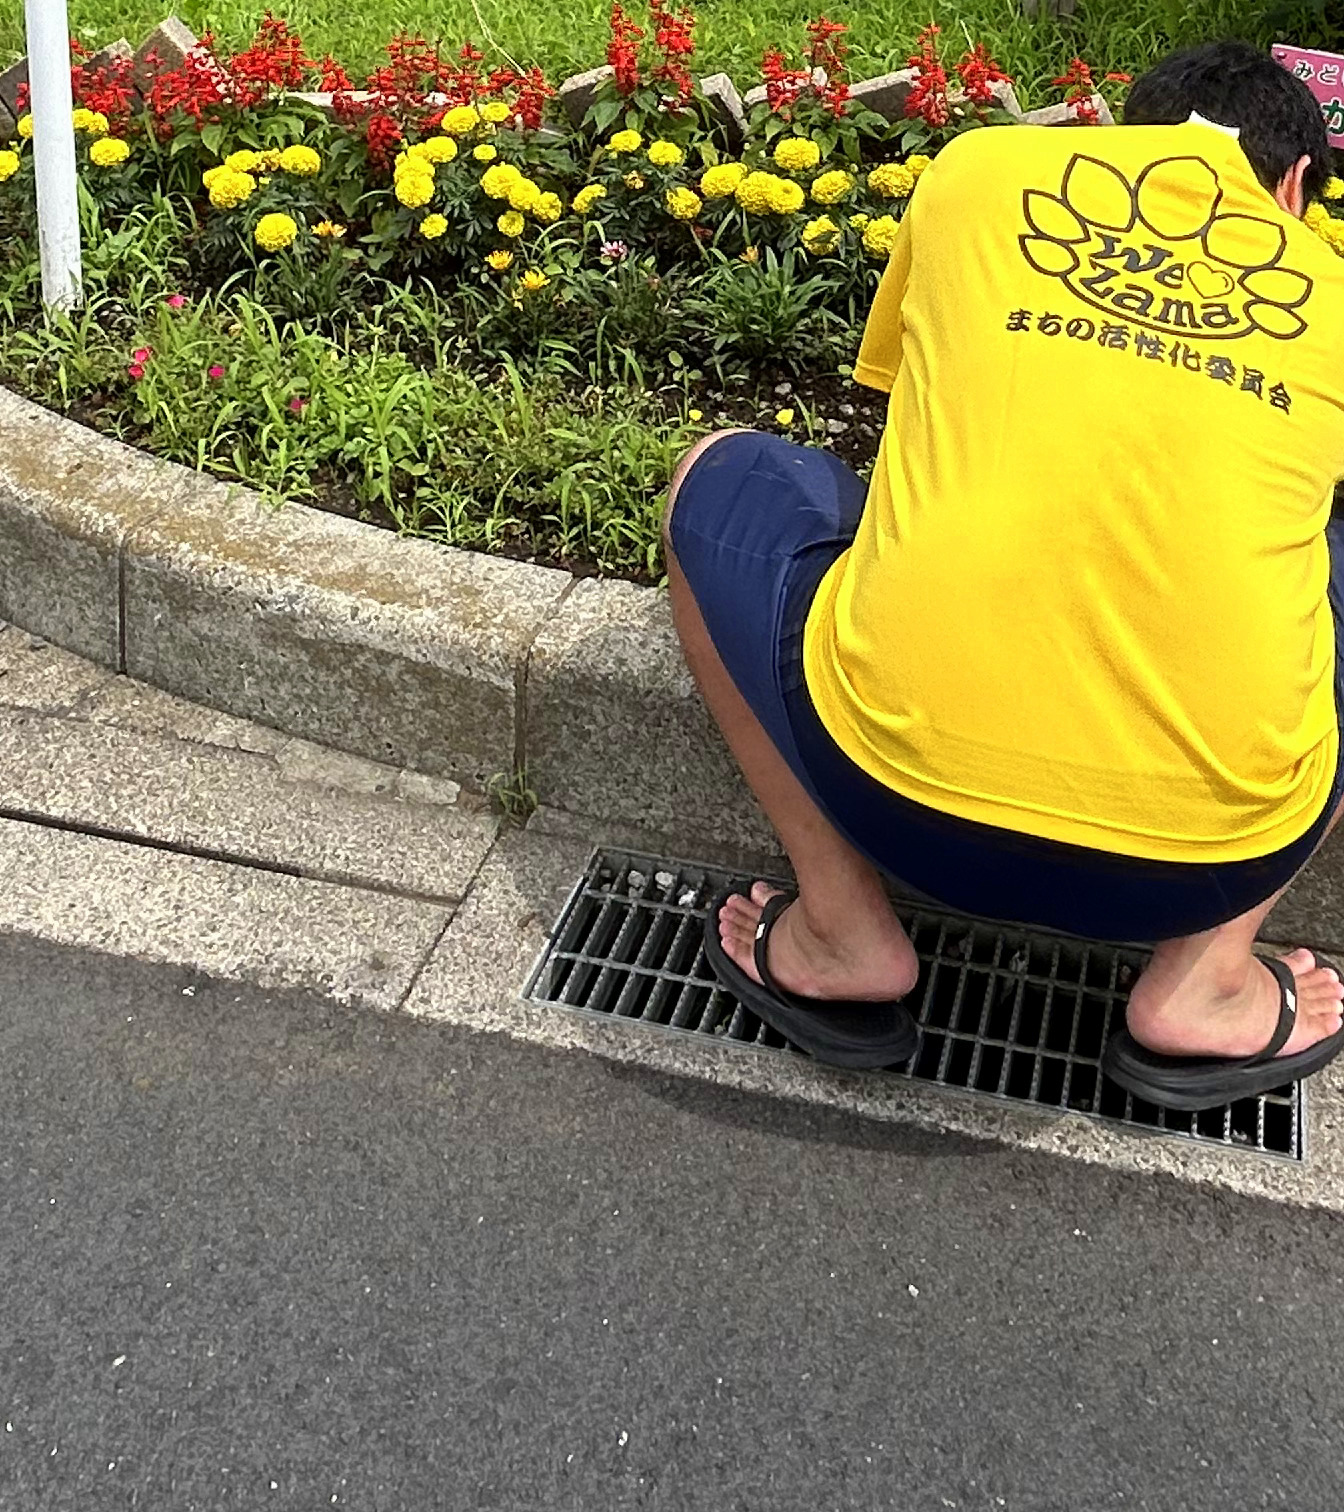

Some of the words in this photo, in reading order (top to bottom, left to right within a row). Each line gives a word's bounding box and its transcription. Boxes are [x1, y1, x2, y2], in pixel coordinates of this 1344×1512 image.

[1089, 232, 1187, 290] We
[1006, 309, 1292, 415] まちの活性化委員会
